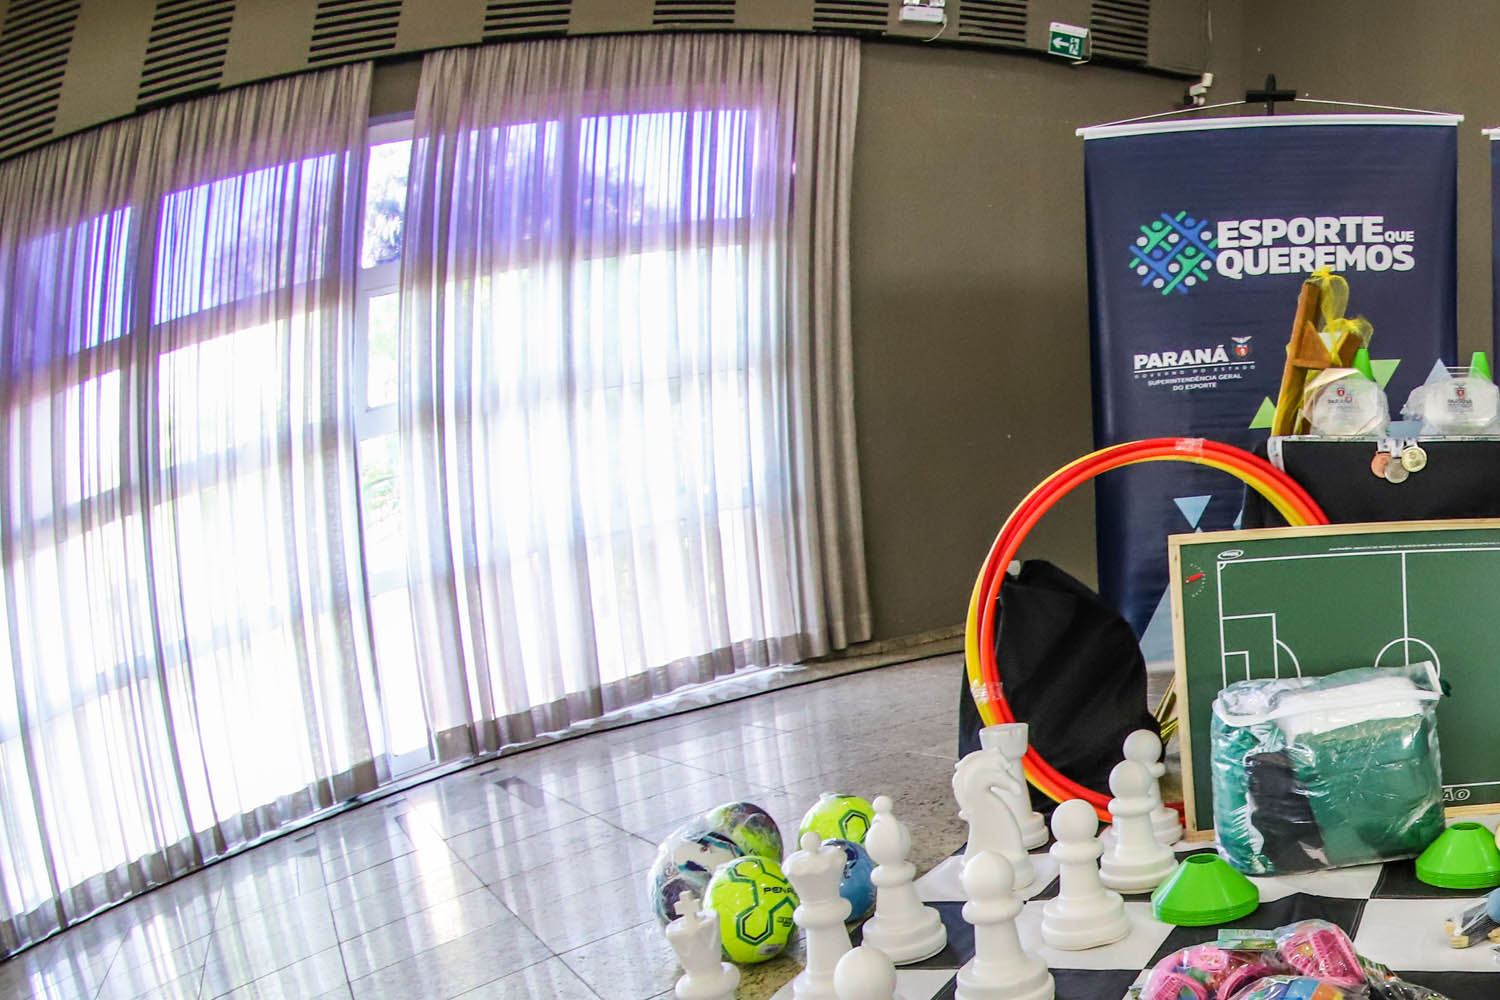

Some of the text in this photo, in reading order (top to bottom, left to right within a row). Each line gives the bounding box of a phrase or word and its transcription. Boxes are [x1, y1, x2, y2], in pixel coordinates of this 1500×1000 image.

[1217, 215, 1415, 249] ESPORTE QUE
[1216, 244, 1415, 280] QUEREMOS
[1133, 344, 1230, 370] PARANÁ
[1185, 381, 1217, 390] ESPORTE
[1218, 373, 1243, 381] GERAL
